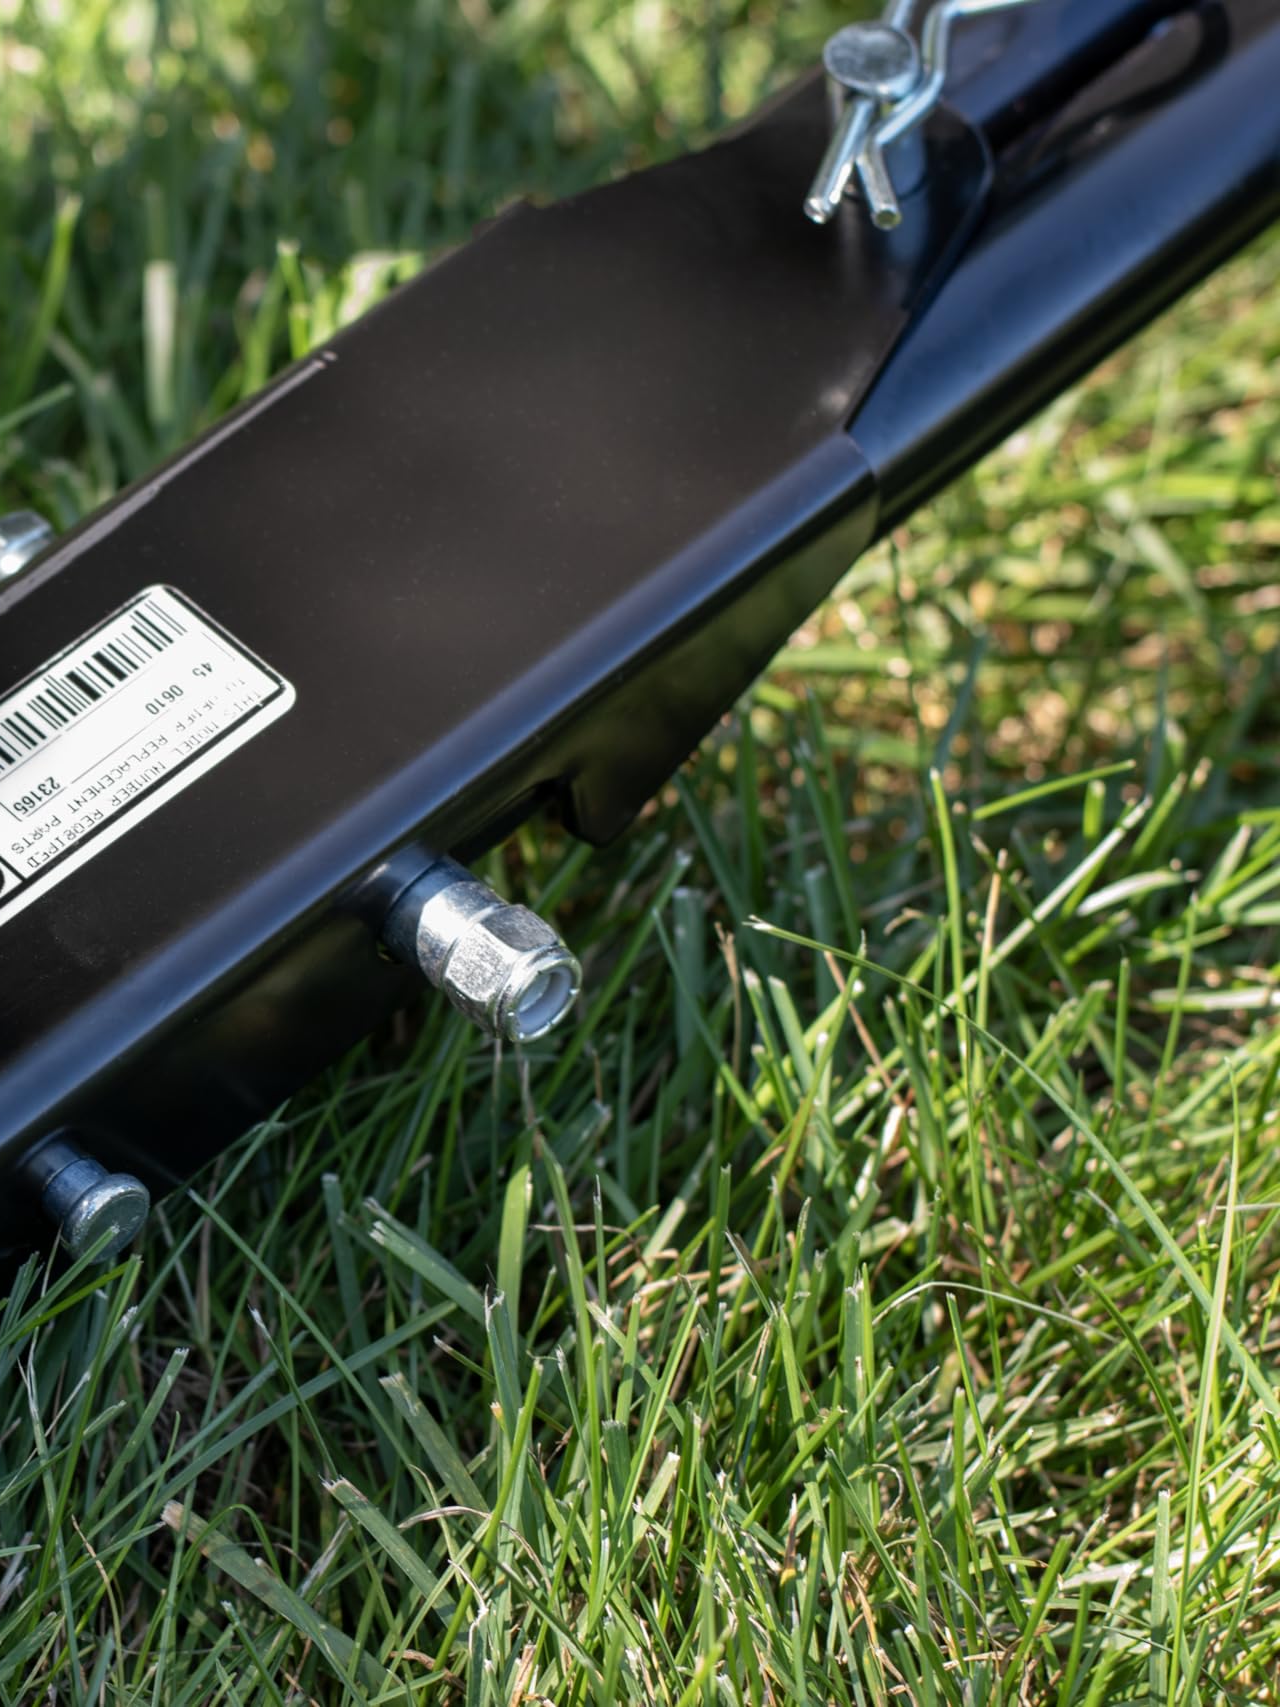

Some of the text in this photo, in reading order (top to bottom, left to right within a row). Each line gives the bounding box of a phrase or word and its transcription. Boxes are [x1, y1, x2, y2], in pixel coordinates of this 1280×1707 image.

[11, 661, 213, 815] 45 0610 23165
[172, 720, 220, 756] MODEL
[66, 733, 169, 814] REPLACEMENT
[110, 760, 167, 807] NUMBER
[10, 813, 62, 855] PARTS
